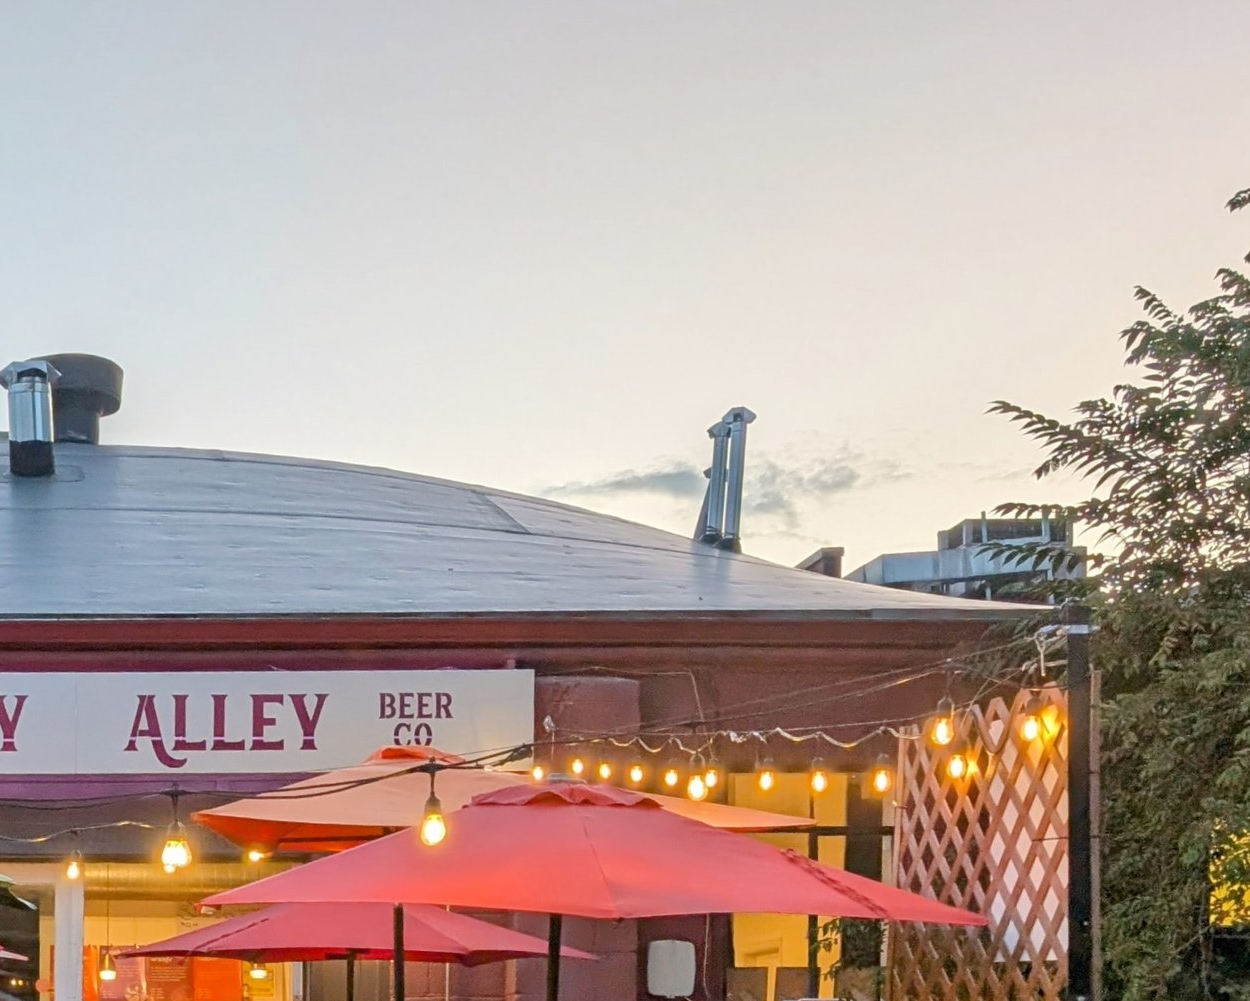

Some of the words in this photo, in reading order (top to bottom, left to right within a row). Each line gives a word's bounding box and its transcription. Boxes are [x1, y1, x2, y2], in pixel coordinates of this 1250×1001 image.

[379, 692, 453, 719] BEER
[124, 693, 330, 768] ALLEY
[393, 723, 433, 746] CO
